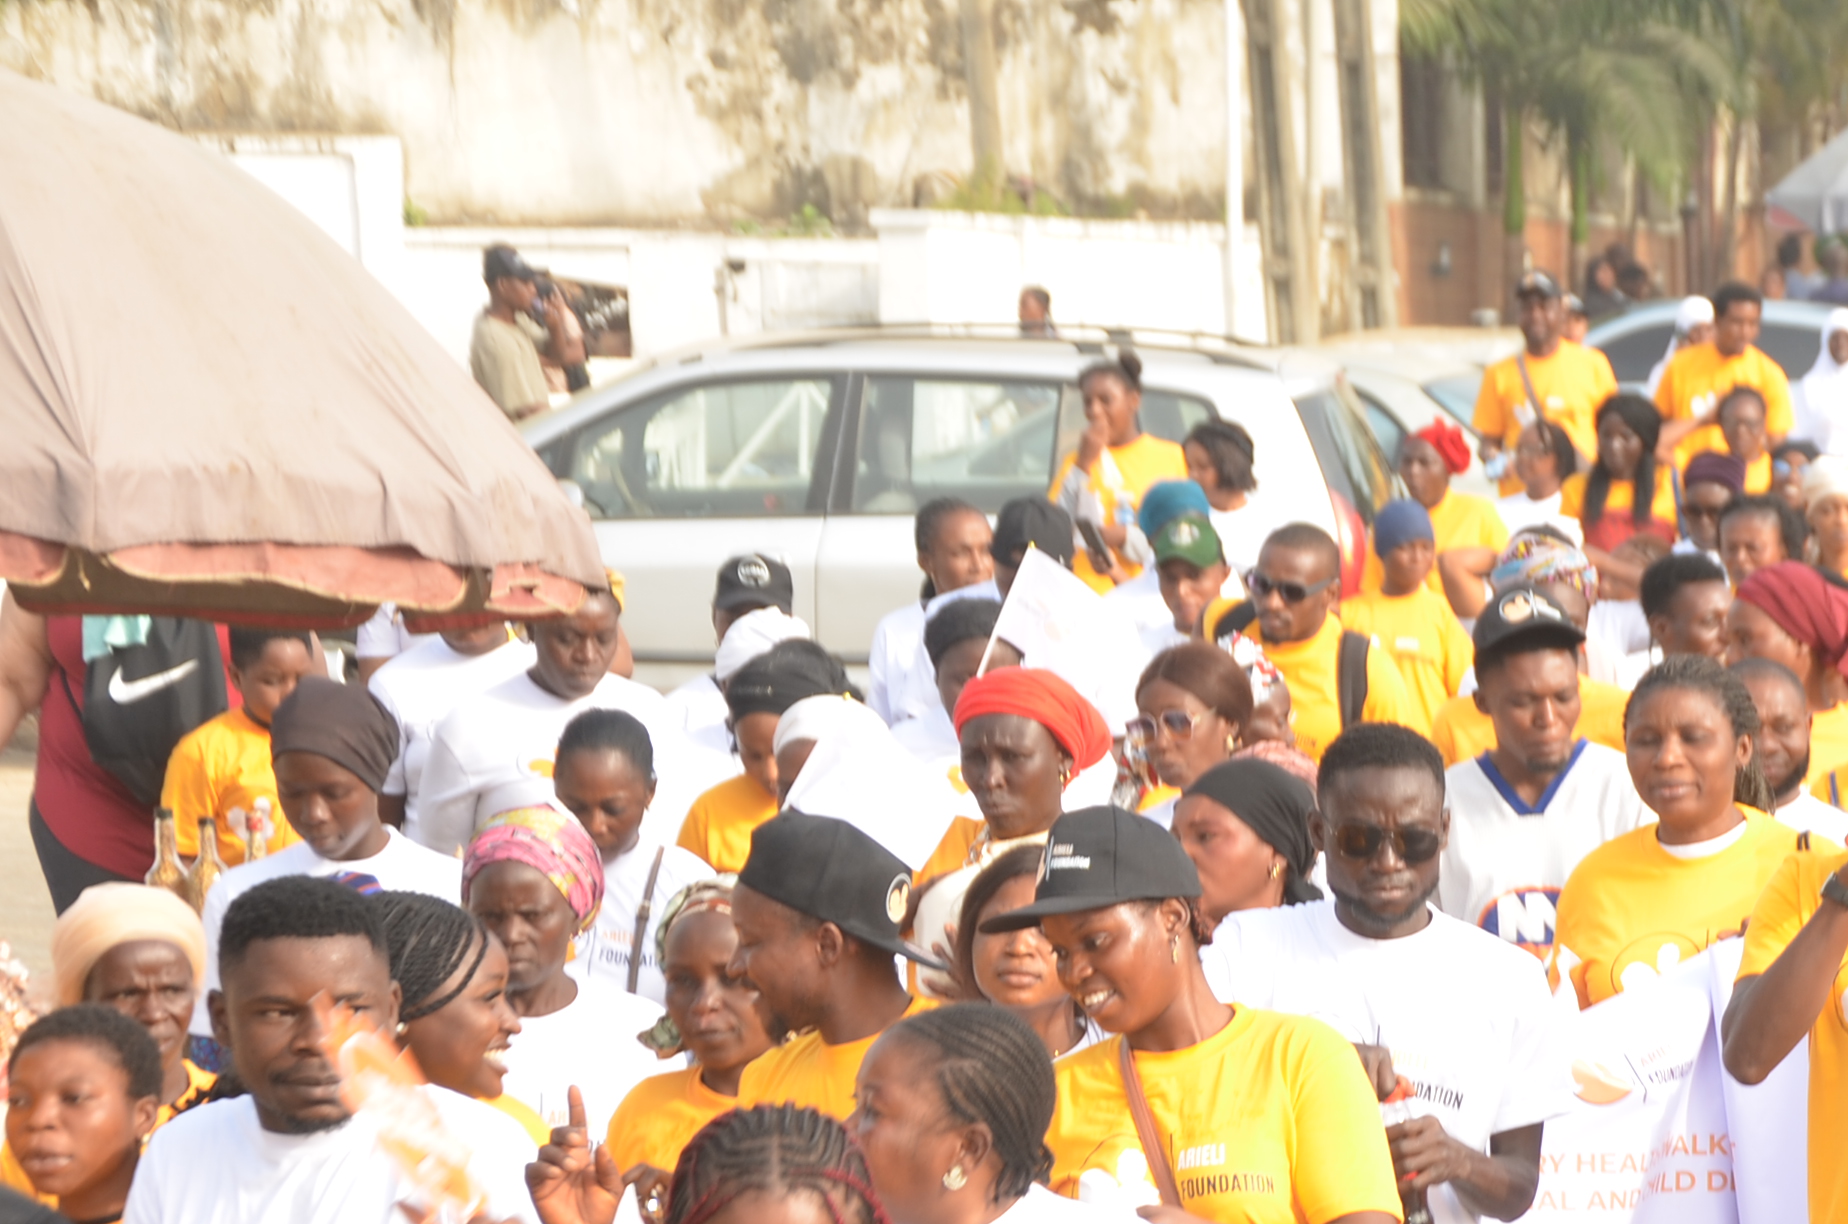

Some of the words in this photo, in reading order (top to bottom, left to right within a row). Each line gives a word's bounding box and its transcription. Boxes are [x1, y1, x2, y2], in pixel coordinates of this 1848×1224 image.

[1412, 1080, 1464, 1110] DATION
[1177, 1142, 1226, 1171] ARIELI
[1180, 1173, 1275, 1201] FOUNDATION
